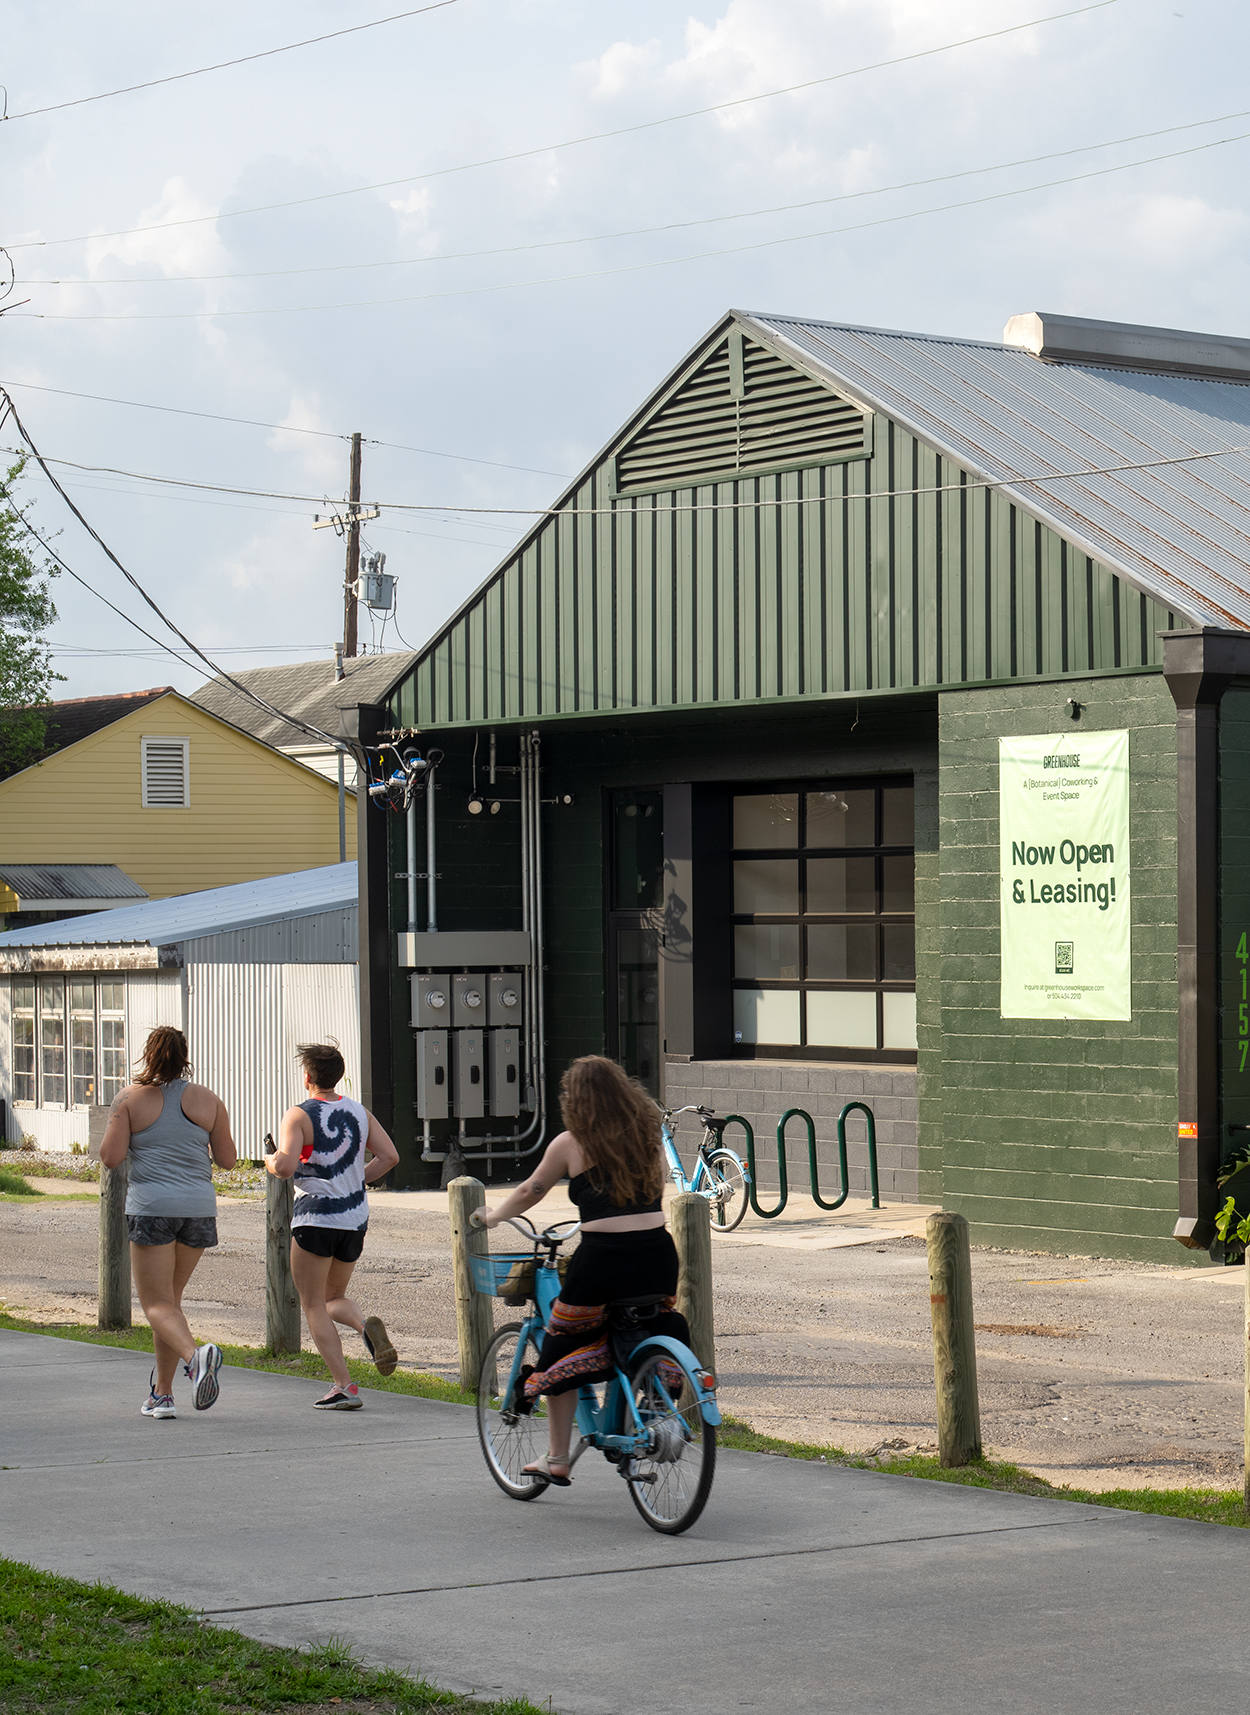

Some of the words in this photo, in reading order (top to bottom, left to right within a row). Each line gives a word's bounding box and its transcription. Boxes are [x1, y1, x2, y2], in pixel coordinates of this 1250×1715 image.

[1043, 754, 1081, 769] GREENHOUSE
[1023, 780, 1028, 789] A
[1061, 777, 1093, 788] Coworking
[1093, 776, 1099, 786] &
[1042, 791, 1060, 801] Event
[1060, 791, 1080, 802] Space
[1012, 840, 1056, 866] Now
[1059, 838, 1115, 872] Open
[1012, 878, 1026, 904] &
[1030, 877, 1116, 911] Leasing!
